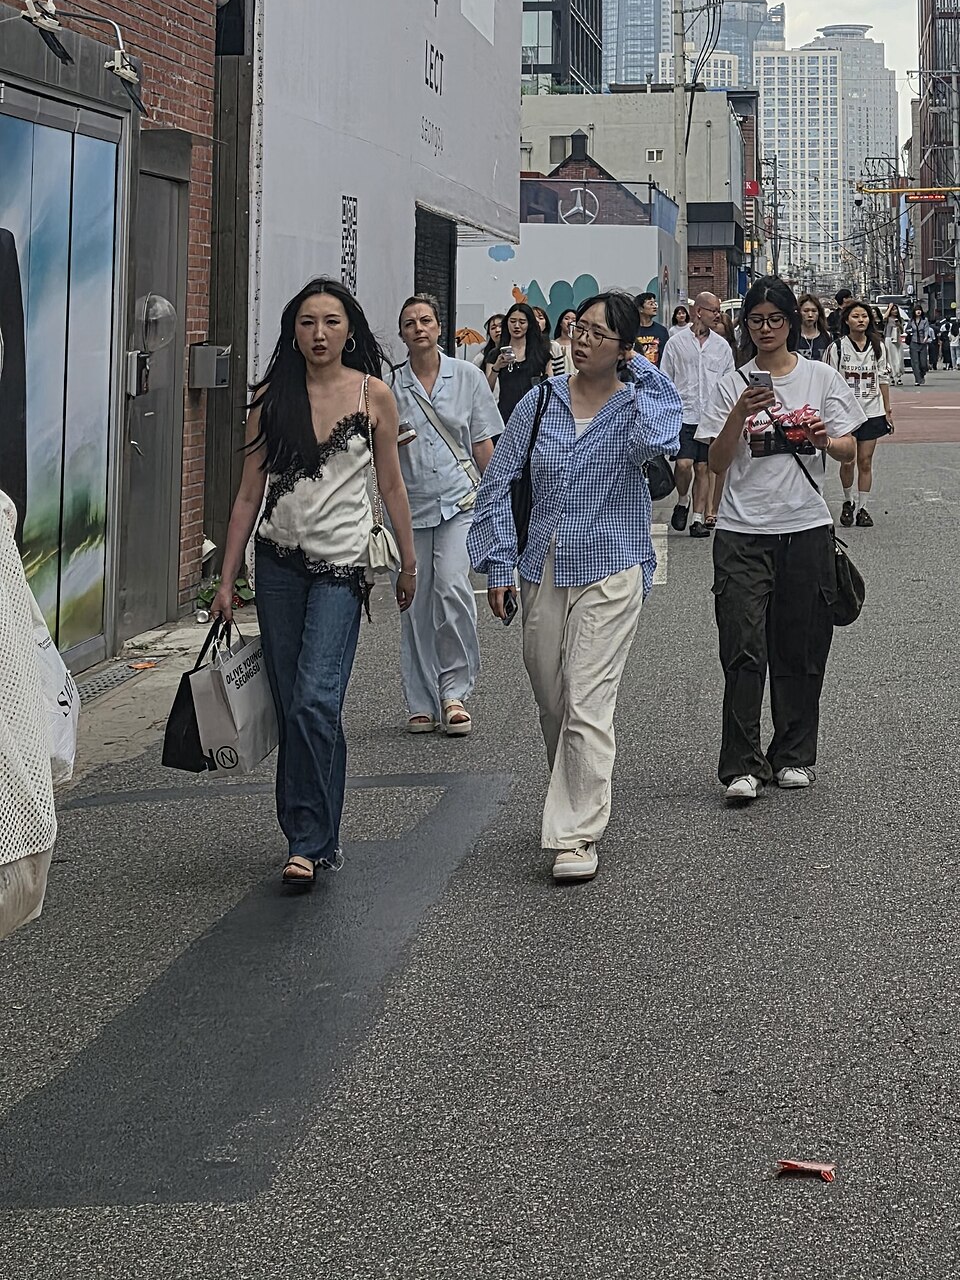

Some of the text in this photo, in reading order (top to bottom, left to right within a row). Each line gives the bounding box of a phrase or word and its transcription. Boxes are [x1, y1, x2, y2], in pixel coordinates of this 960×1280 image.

[425, 39, 444, 97] LECT
[226, 648, 263, 685] OLIVE YOUNG
[234, 661, 261, 690] SEONGSU
